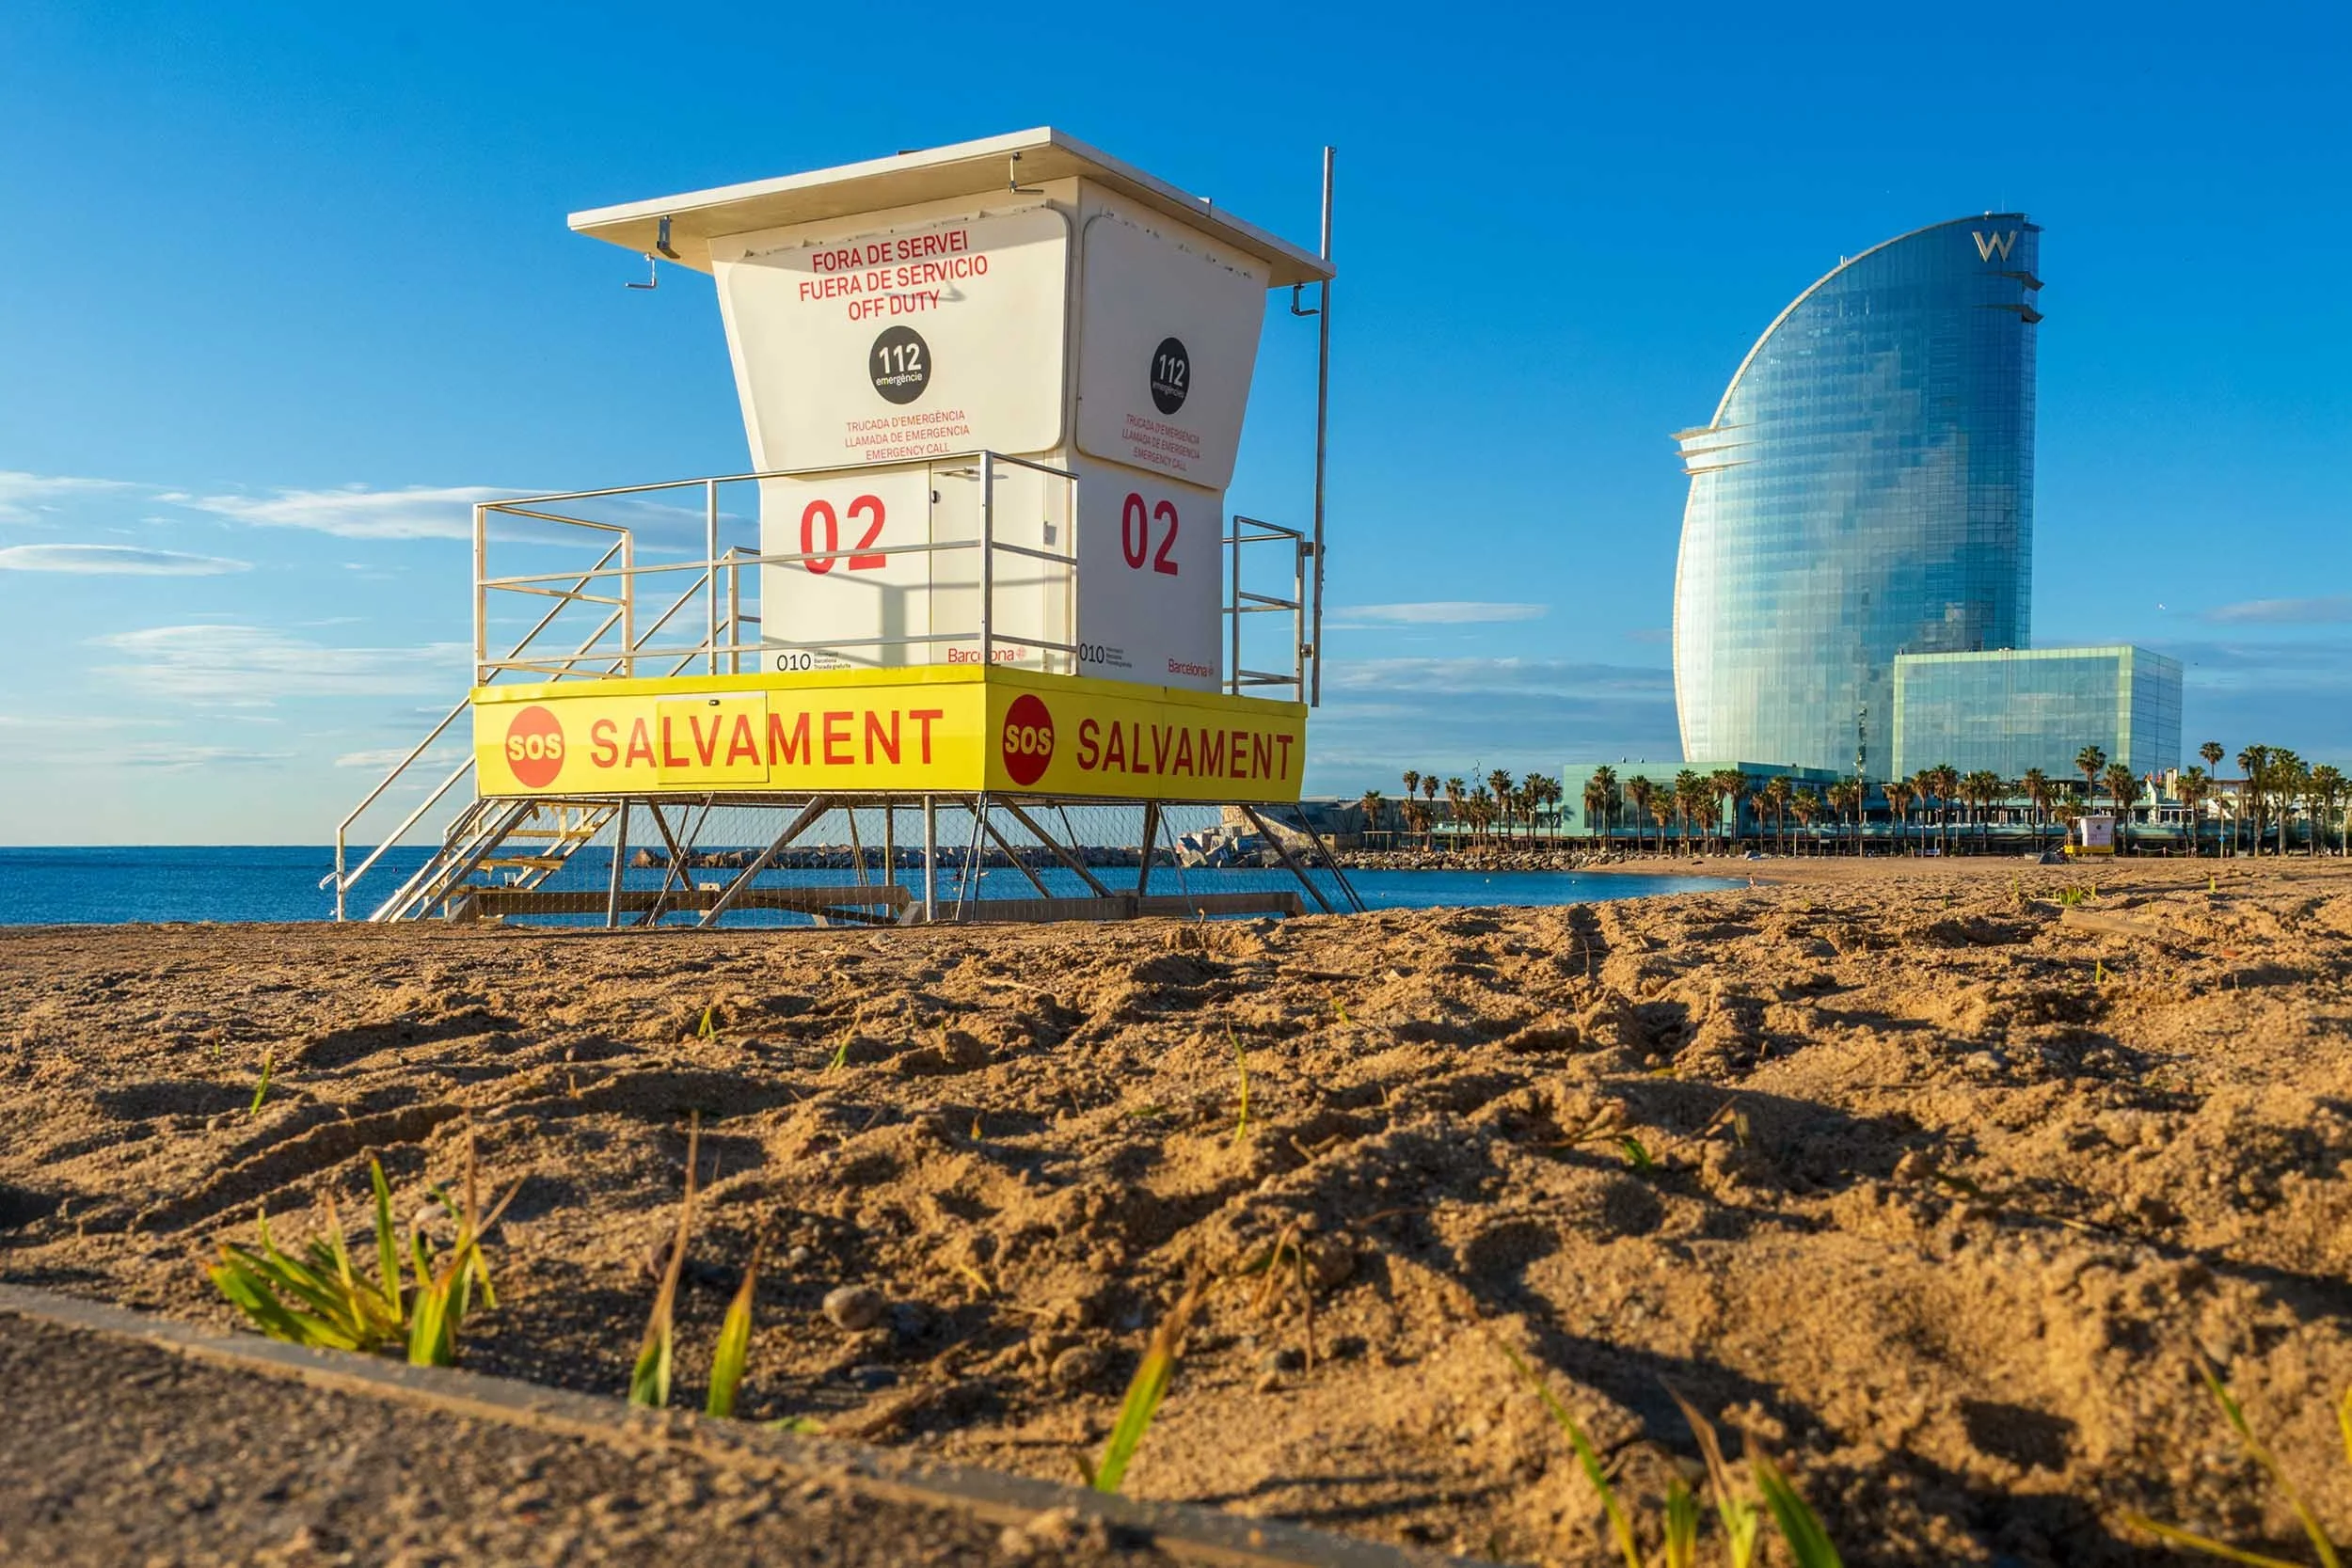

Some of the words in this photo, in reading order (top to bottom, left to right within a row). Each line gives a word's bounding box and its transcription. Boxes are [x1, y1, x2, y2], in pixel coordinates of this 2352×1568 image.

[812, 247, 863, 273] FORA
[866, 242, 893, 265] DE
[898, 230, 968, 261] SERVEI
[1972, 230, 2018, 262] W
[799, 275, 862, 302] FUERA
[866, 270, 893, 292] DE
[898, 255, 989, 288] SERVICIO
[849, 297, 884, 321] OFF
[890, 289, 940, 315] DUTY
[879, 342, 922, 374] 112
[1159, 354, 1185, 387] 112
[845, 434, 889, 448] LLAMADA
[890, 432, 903, 442] DE
[905, 424, 970, 441] EMERGENCIA
[847, 419, 889, 432] TRUCADA
[891, 409, 966, 428] D'EMERGÈNCIA
[866, 445, 926, 460] EMERGENCY
[926, 442, 950, 454] CALL
[801, 495, 886, 575] 02
[1121, 492, 1179, 576] 02
[776, 653, 811, 672] 010
[1079, 642, 1104, 664] 010
[1168, 658, 1208, 677] Barcelona
[507, 735, 562, 760] SOS
[591, 709, 944, 768] SALVAMENT
[1004, 724, 1053, 754] SOS
[1077, 718, 1294, 780] SALVAMENT
